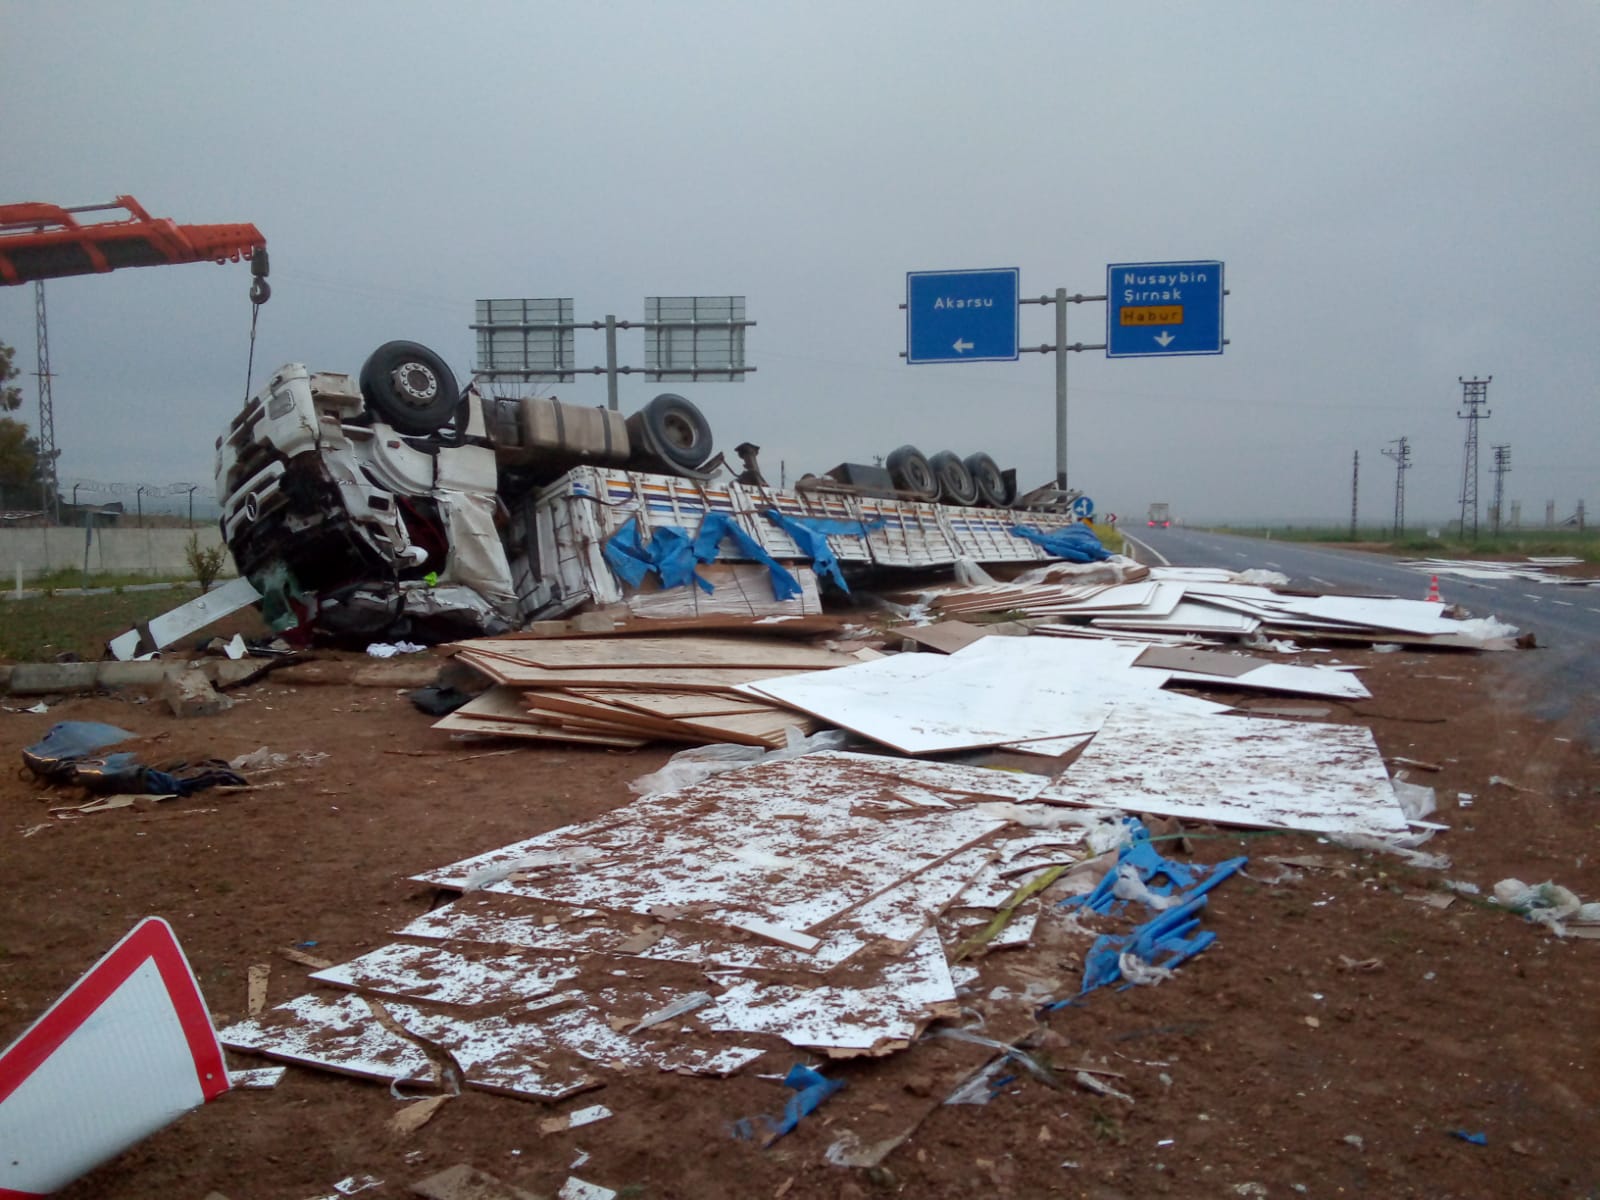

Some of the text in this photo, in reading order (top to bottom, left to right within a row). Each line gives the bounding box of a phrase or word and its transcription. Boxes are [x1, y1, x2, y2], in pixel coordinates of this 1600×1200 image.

[1124, 272, 1207, 286] Nusaybin
[1124, 288, 1182, 303] Şırnak
[934, 296, 993, 309] Akarsu
[1123, 310, 1179, 322] Habur
